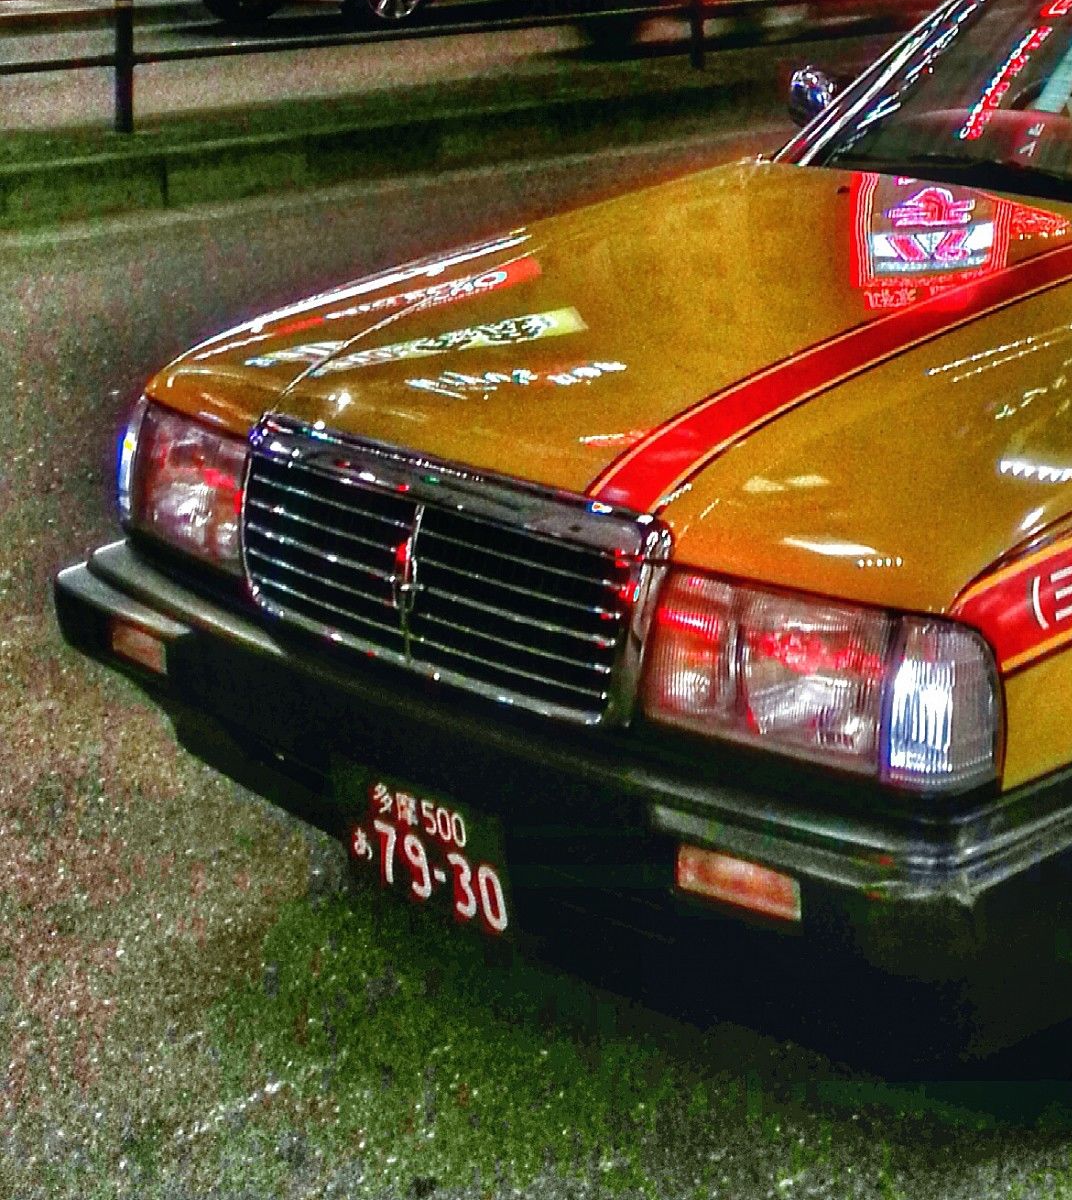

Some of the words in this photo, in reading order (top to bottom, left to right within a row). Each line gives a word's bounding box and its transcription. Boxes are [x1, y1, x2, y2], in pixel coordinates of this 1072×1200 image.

[420, 800, 467, 848] 500
[354, 827, 373, 860] あ
[373, 819, 508, 932] 79-30
